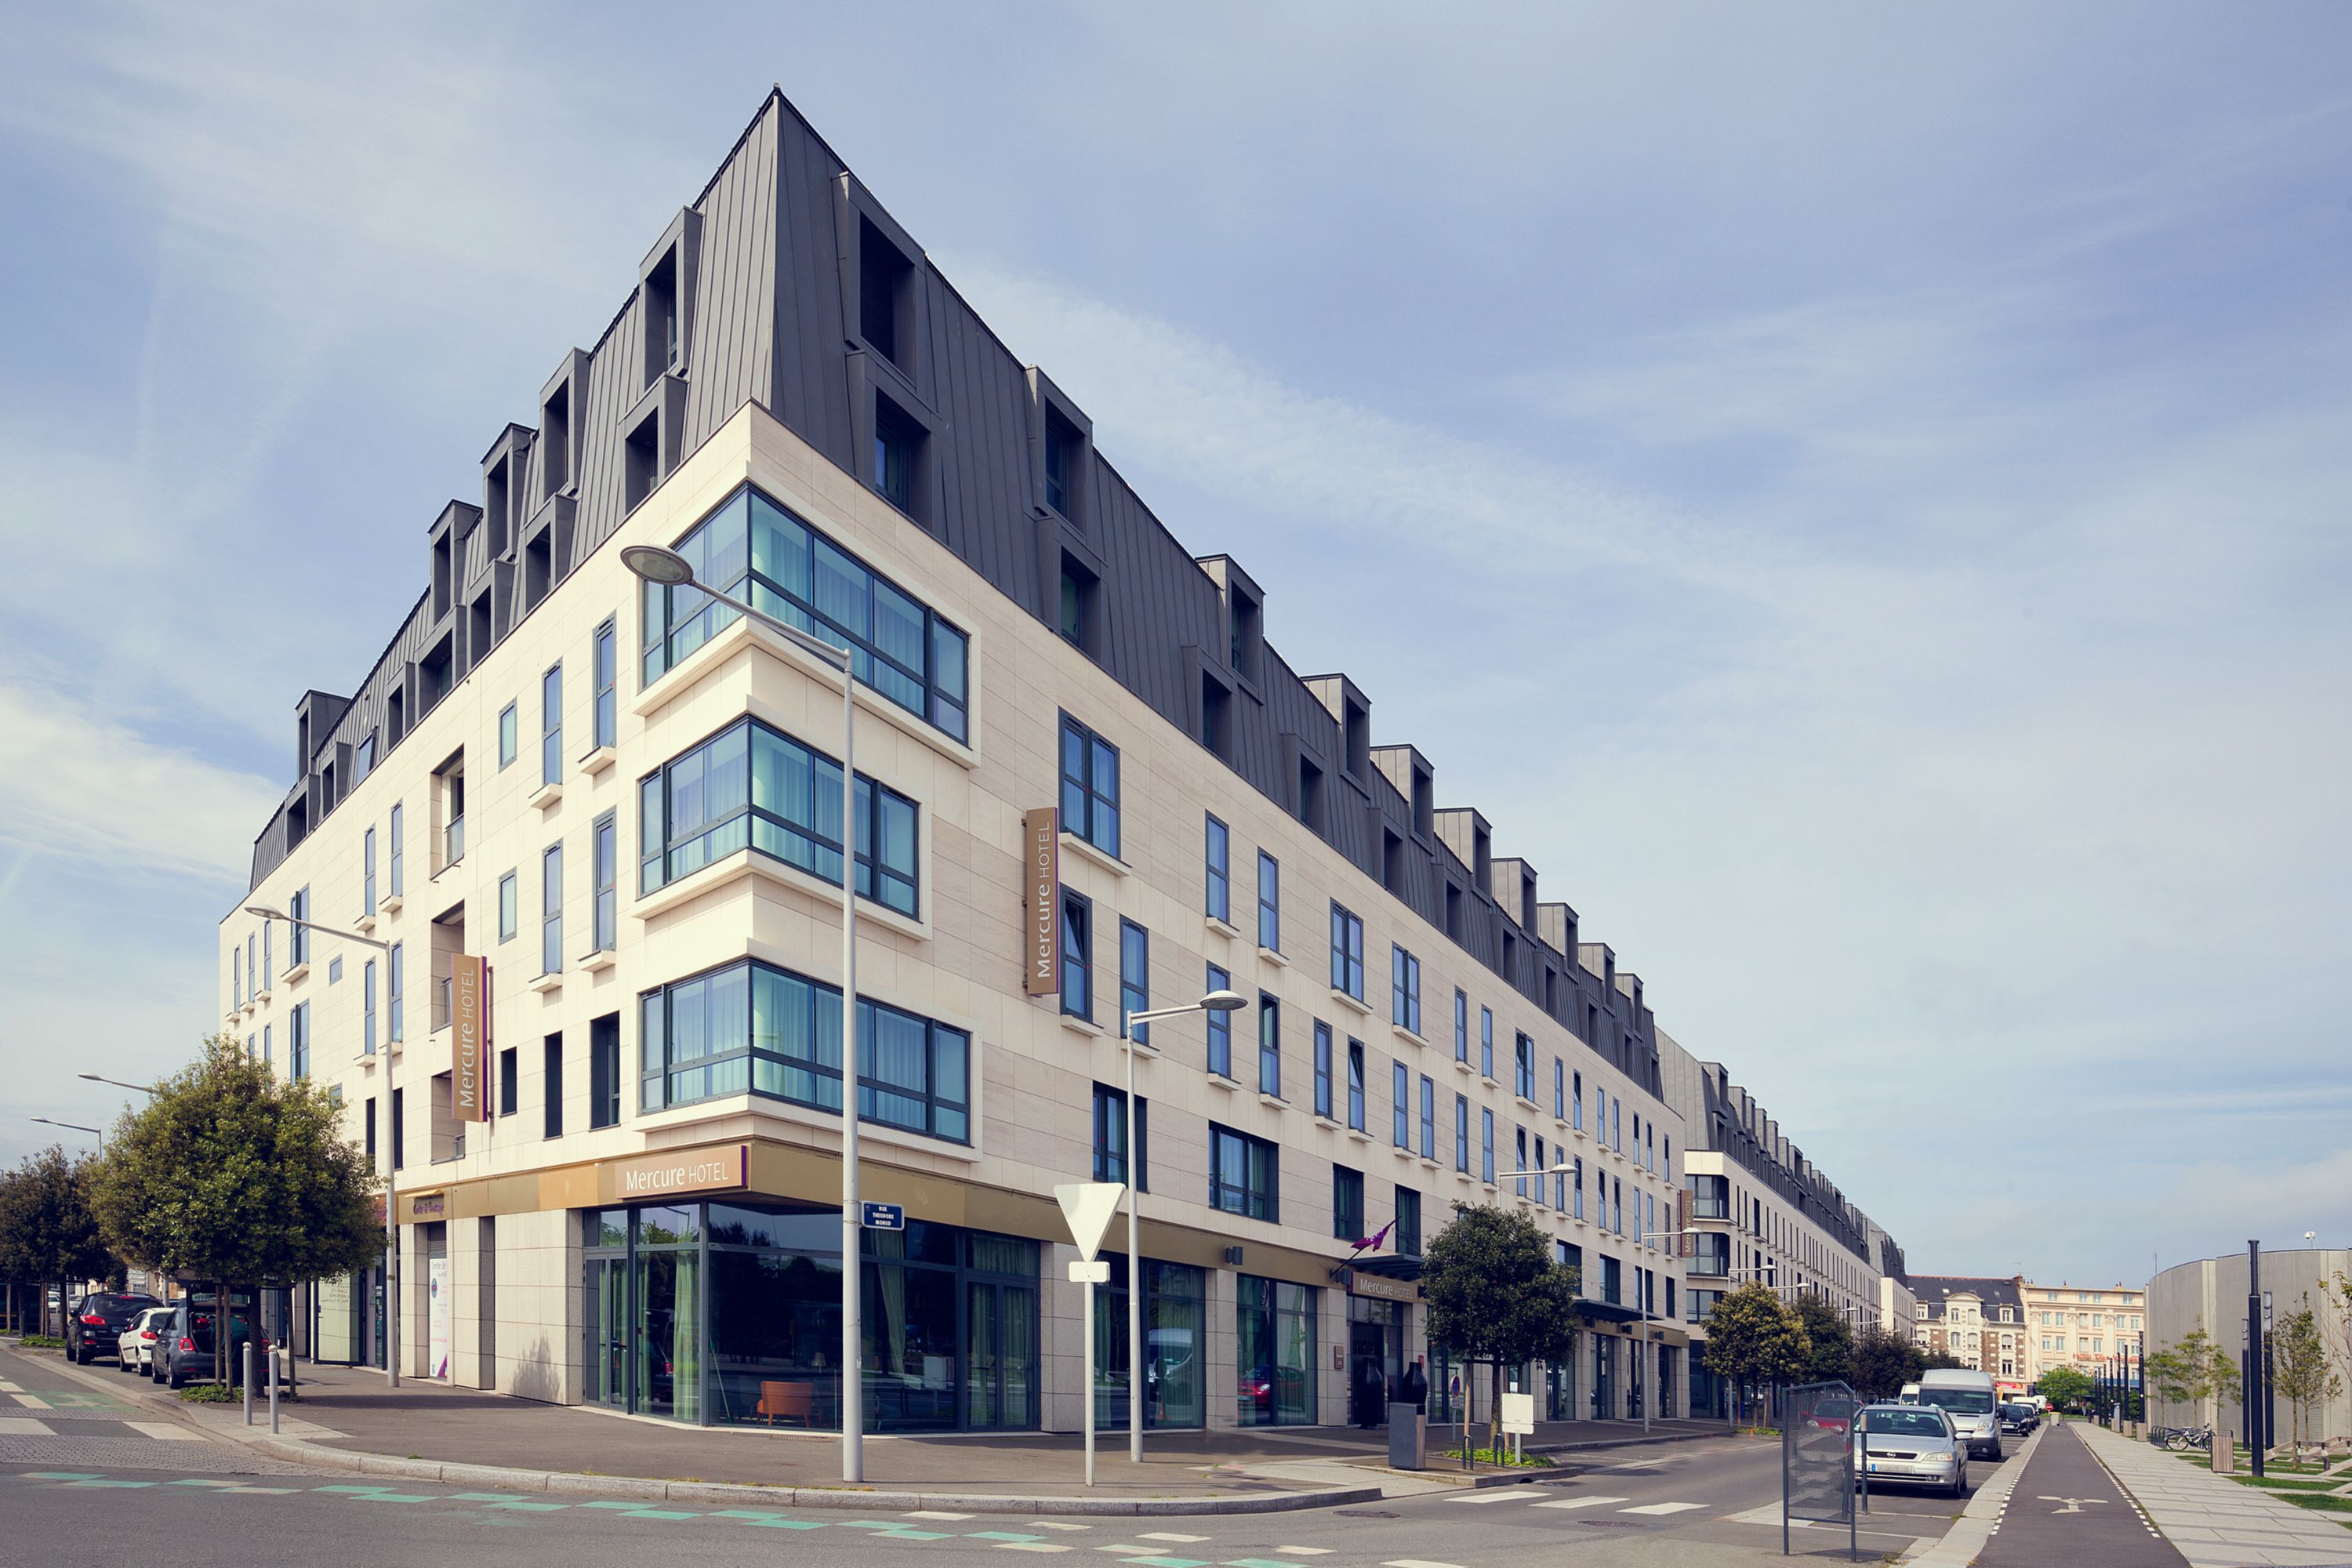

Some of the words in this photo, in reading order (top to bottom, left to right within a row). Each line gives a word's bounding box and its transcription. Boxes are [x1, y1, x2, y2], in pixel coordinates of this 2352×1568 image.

[1038, 822, 1051, 879] HOTEL
[1037, 884, 1051, 978] Mercure
[461, 968, 474, 1018] HOTEL
[459, 1022, 474, 1107] Mercure
[626, 1167, 685, 1192] Mercure
[688, 1162, 728, 1184] HOTEL
[1360, 1278, 1393, 1296] Mercure
[1394, 1287, 1413, 1300] HOTEL
